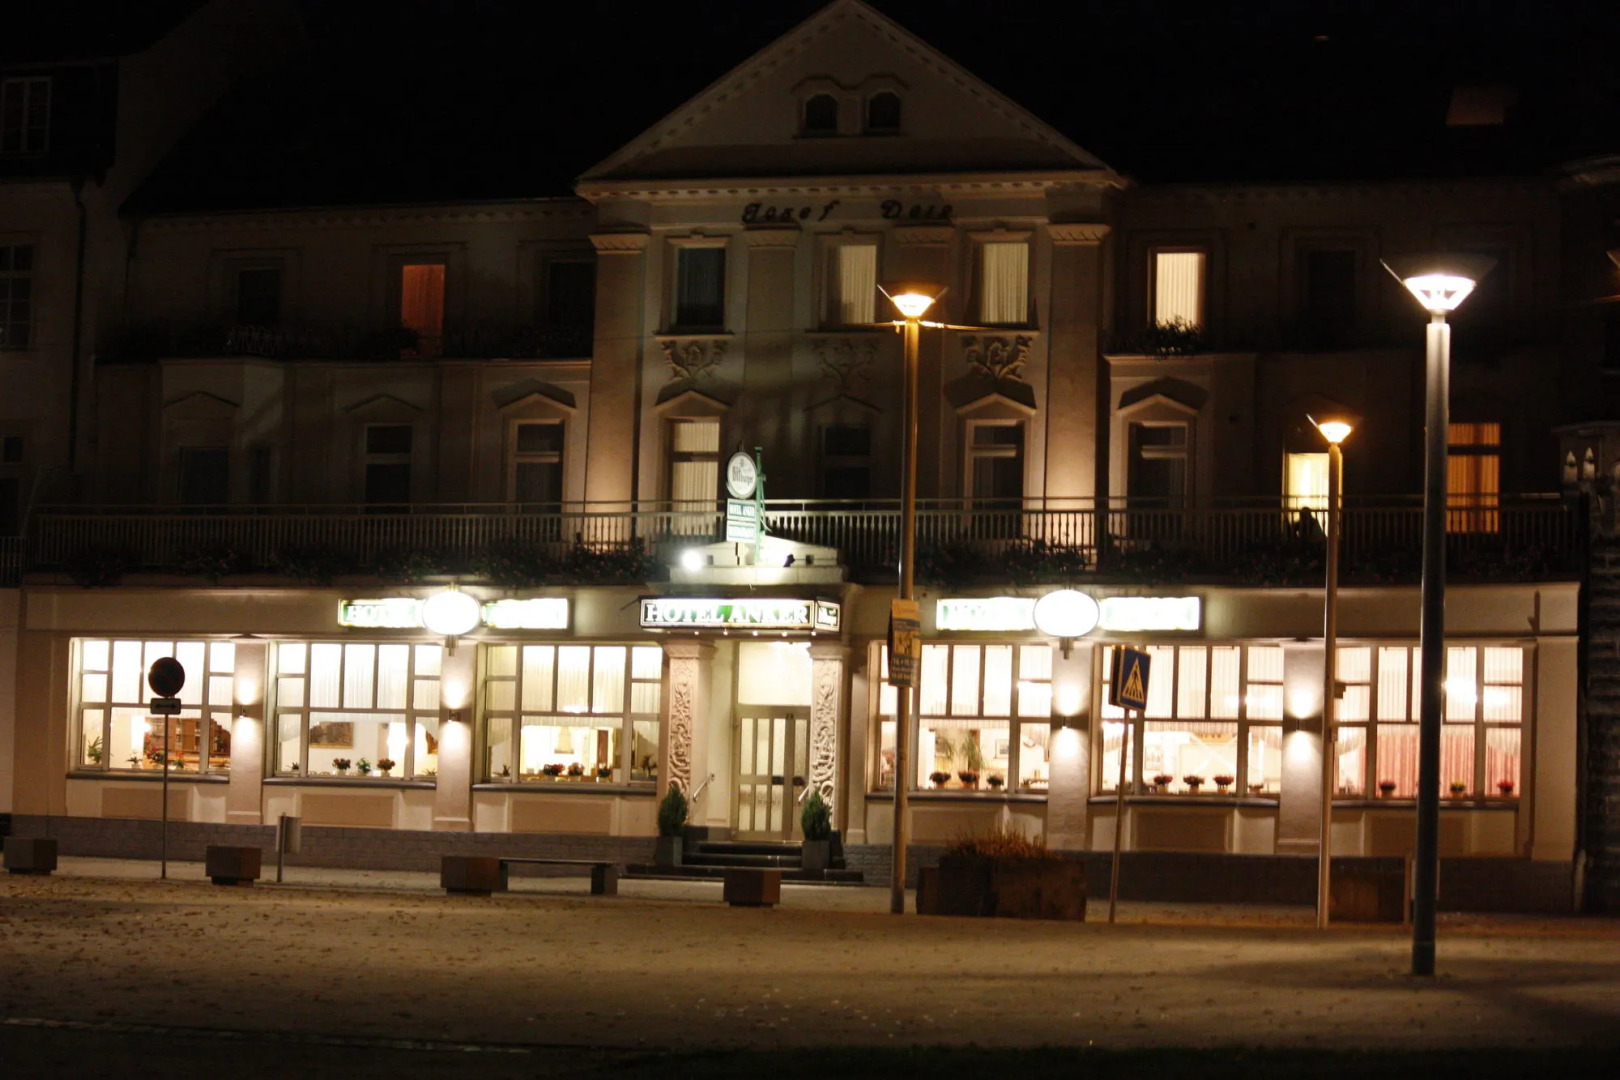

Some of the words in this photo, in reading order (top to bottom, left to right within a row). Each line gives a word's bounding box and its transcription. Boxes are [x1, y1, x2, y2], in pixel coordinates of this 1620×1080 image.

[742, 200, 840, 222] Josef
[646, 604, 724, 623] HOTEL
[730, 603, 808, 624] ANKER
